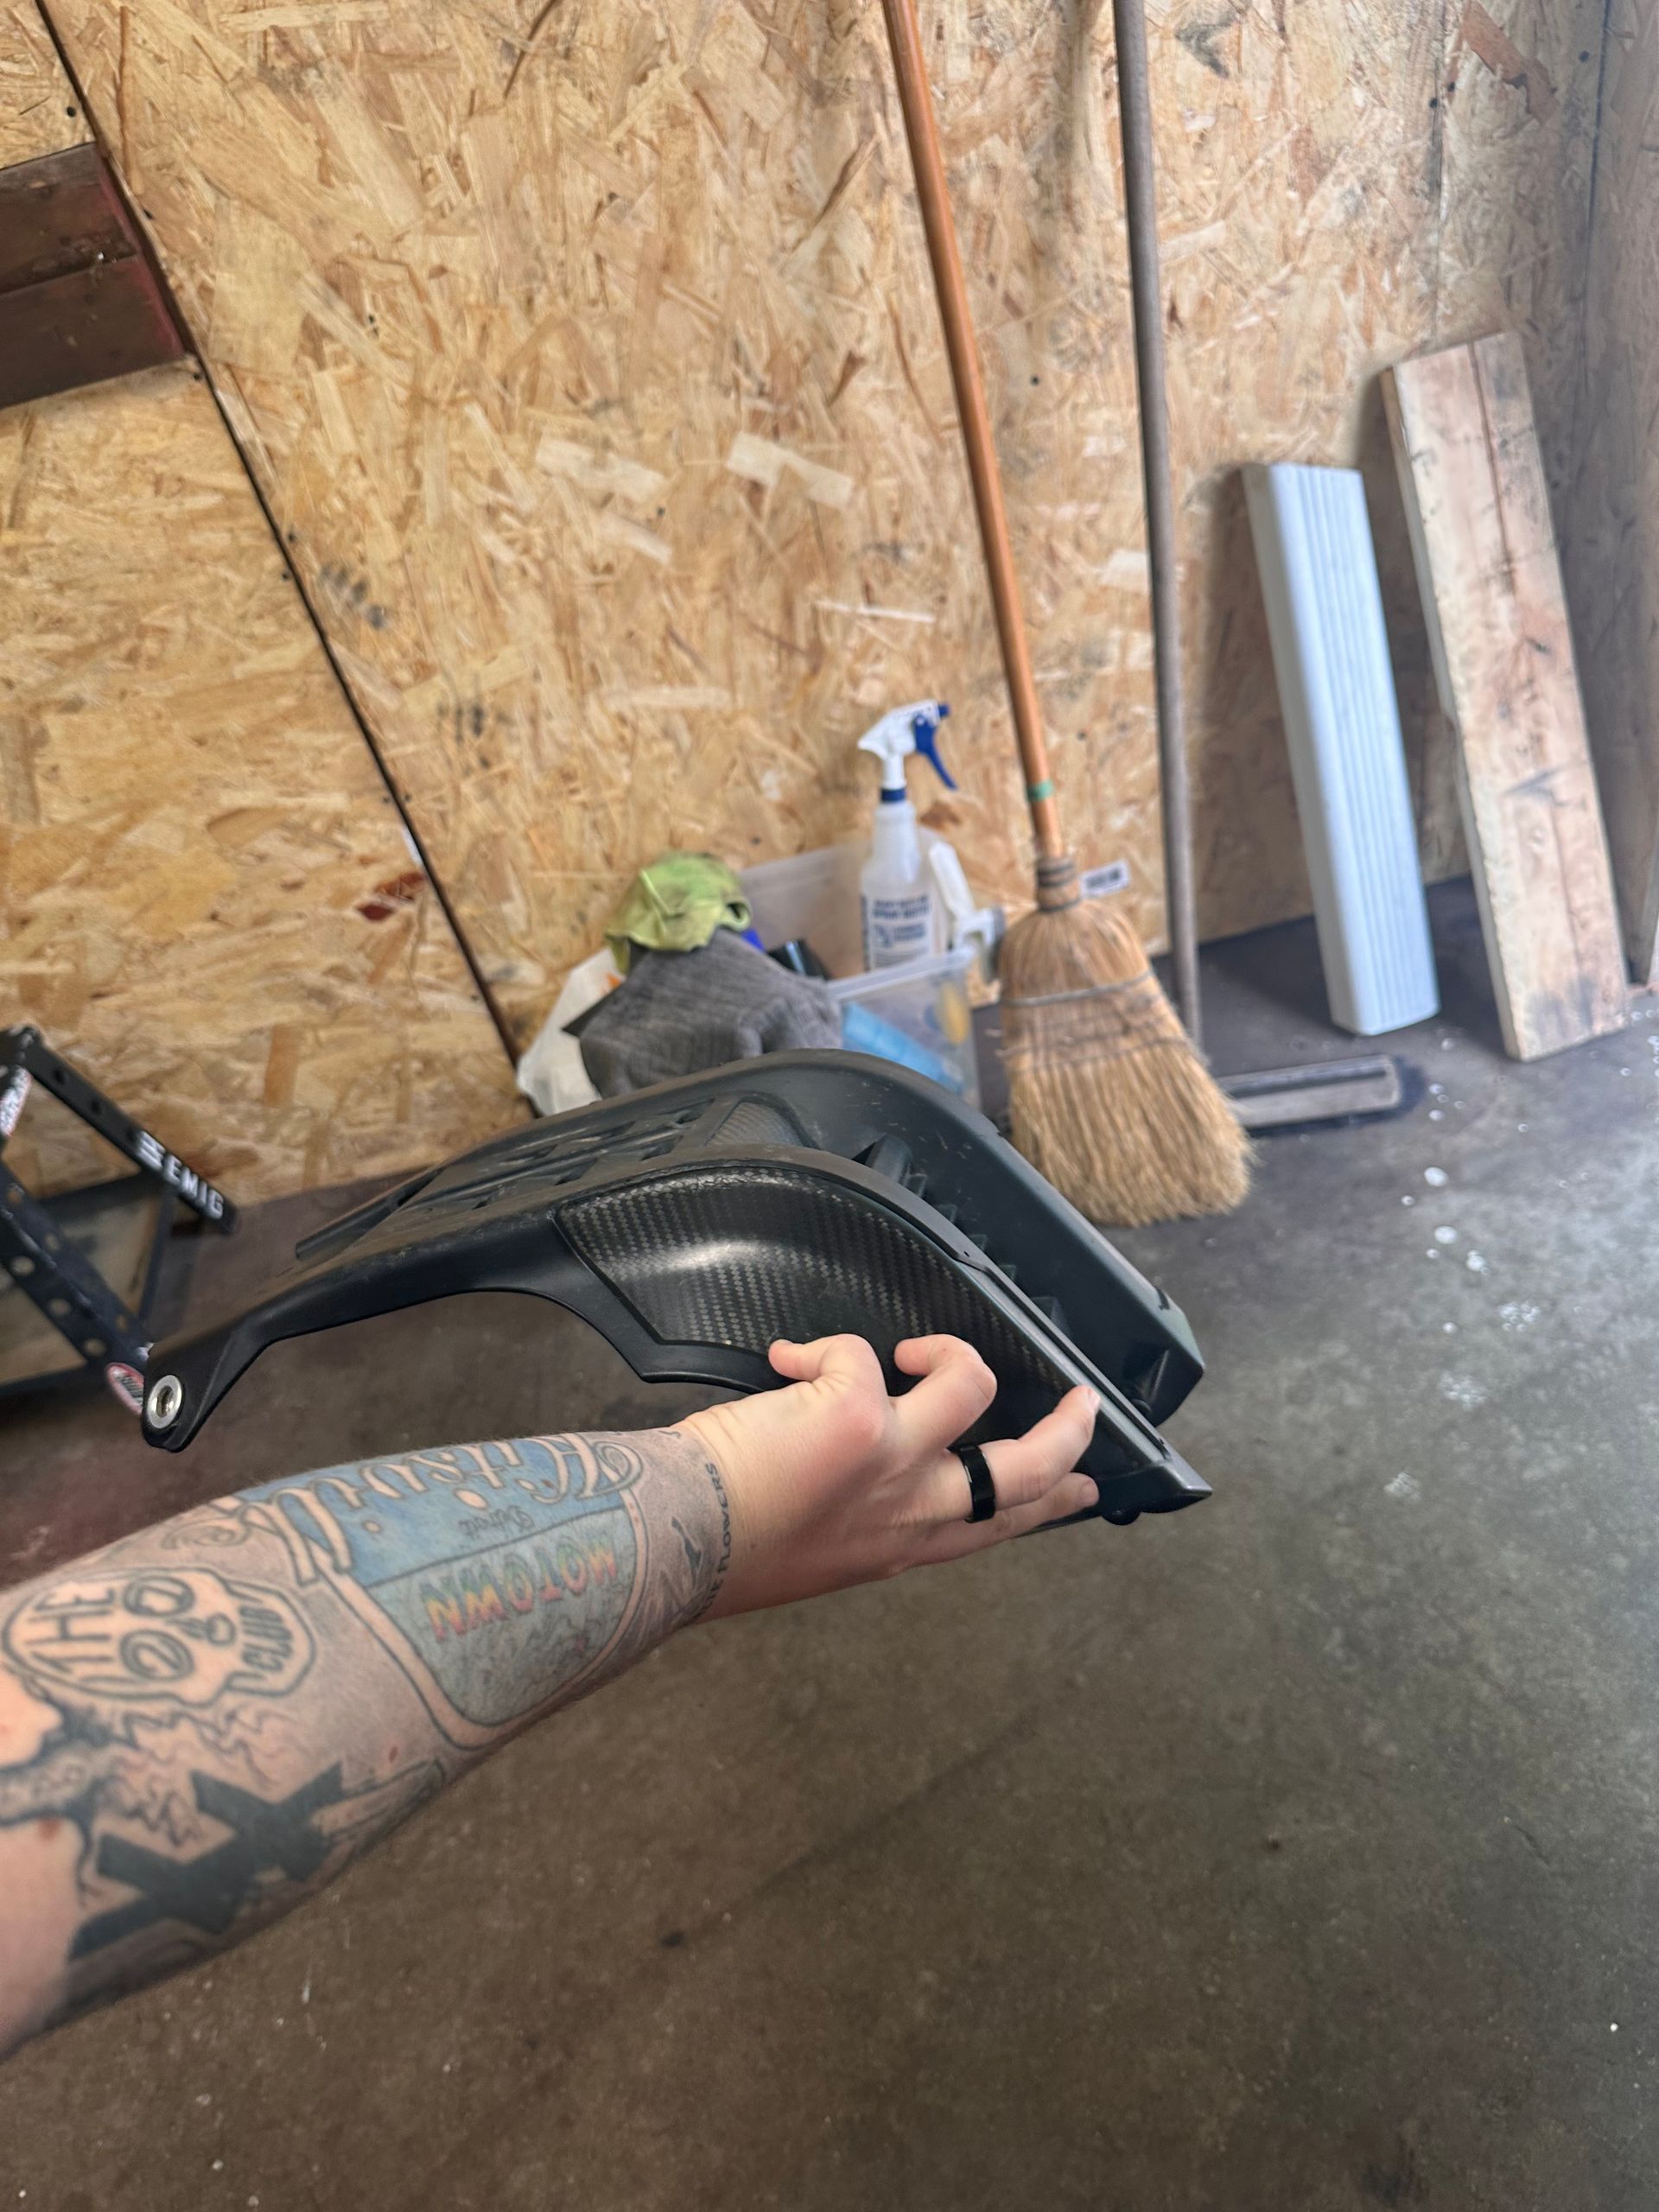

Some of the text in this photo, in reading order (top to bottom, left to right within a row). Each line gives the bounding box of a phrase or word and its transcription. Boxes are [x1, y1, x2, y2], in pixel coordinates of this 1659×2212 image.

[704, 1462, 732, 1573] FLOWERS
[26, 1587, 114, 1673] THE
[420, 1536, 619, 1642] MOTOWN
[238, 1605, 293, 1672] CLUB
